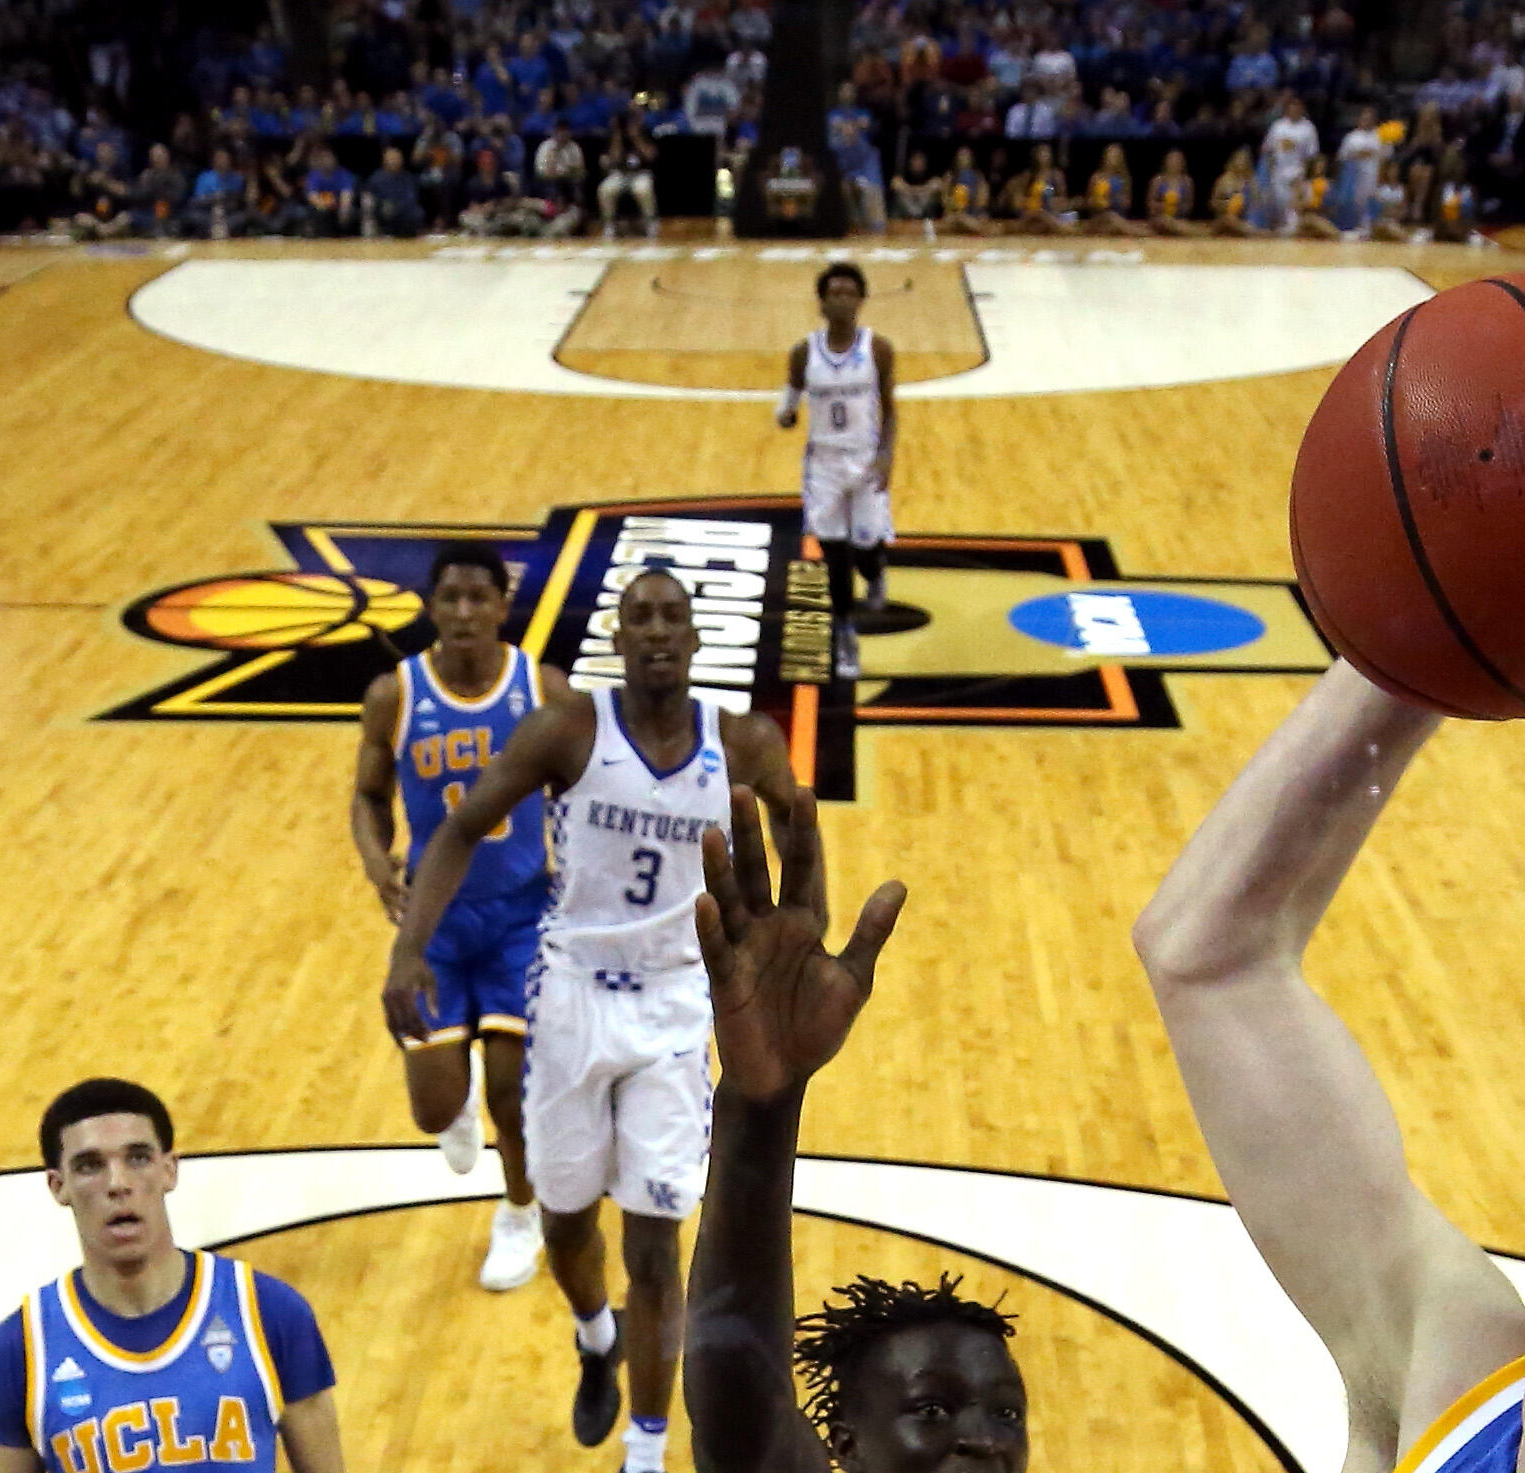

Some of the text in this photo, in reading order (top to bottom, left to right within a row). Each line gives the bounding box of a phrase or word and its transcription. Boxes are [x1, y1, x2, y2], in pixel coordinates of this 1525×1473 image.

[831, 402, 847, 430] 0
[568, 516, 772, 714] REGION
[779, 610, 835, 684] SOUTH
[411, 726, 502, 780] UCL
[625, 847, 662, 906] 3
